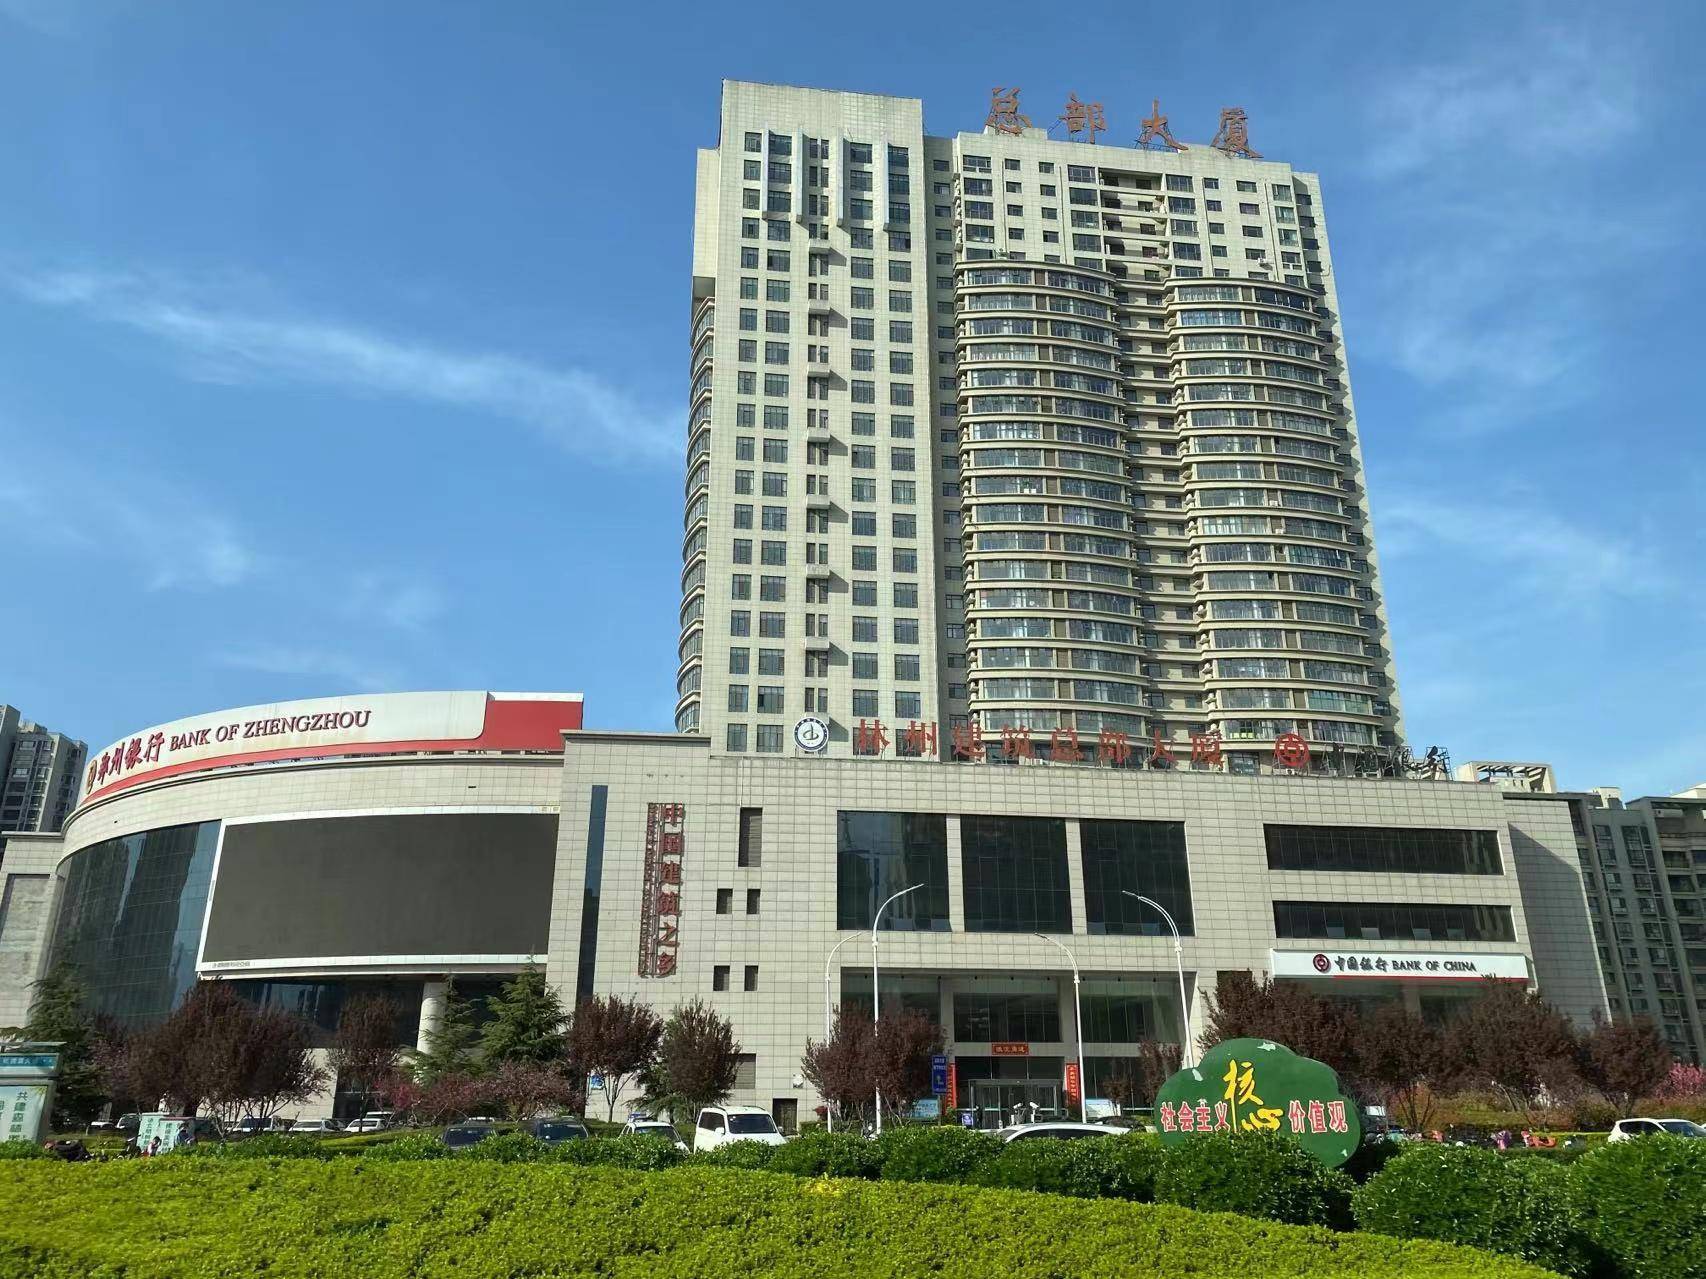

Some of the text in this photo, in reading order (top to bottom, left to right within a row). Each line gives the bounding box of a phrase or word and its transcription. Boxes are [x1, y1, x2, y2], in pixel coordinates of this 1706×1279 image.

[169, 710, 372, 752] BANK OF ZHENGZHOU
[97, 731, 165, 785] 郑州银行
[1334, 955, 1389, 972] 中国银行
[1392, 960, 1478, 972] BANK OF CHINA
[1159, 1058, 1349, 1134] 社会主义 核心 价值观
